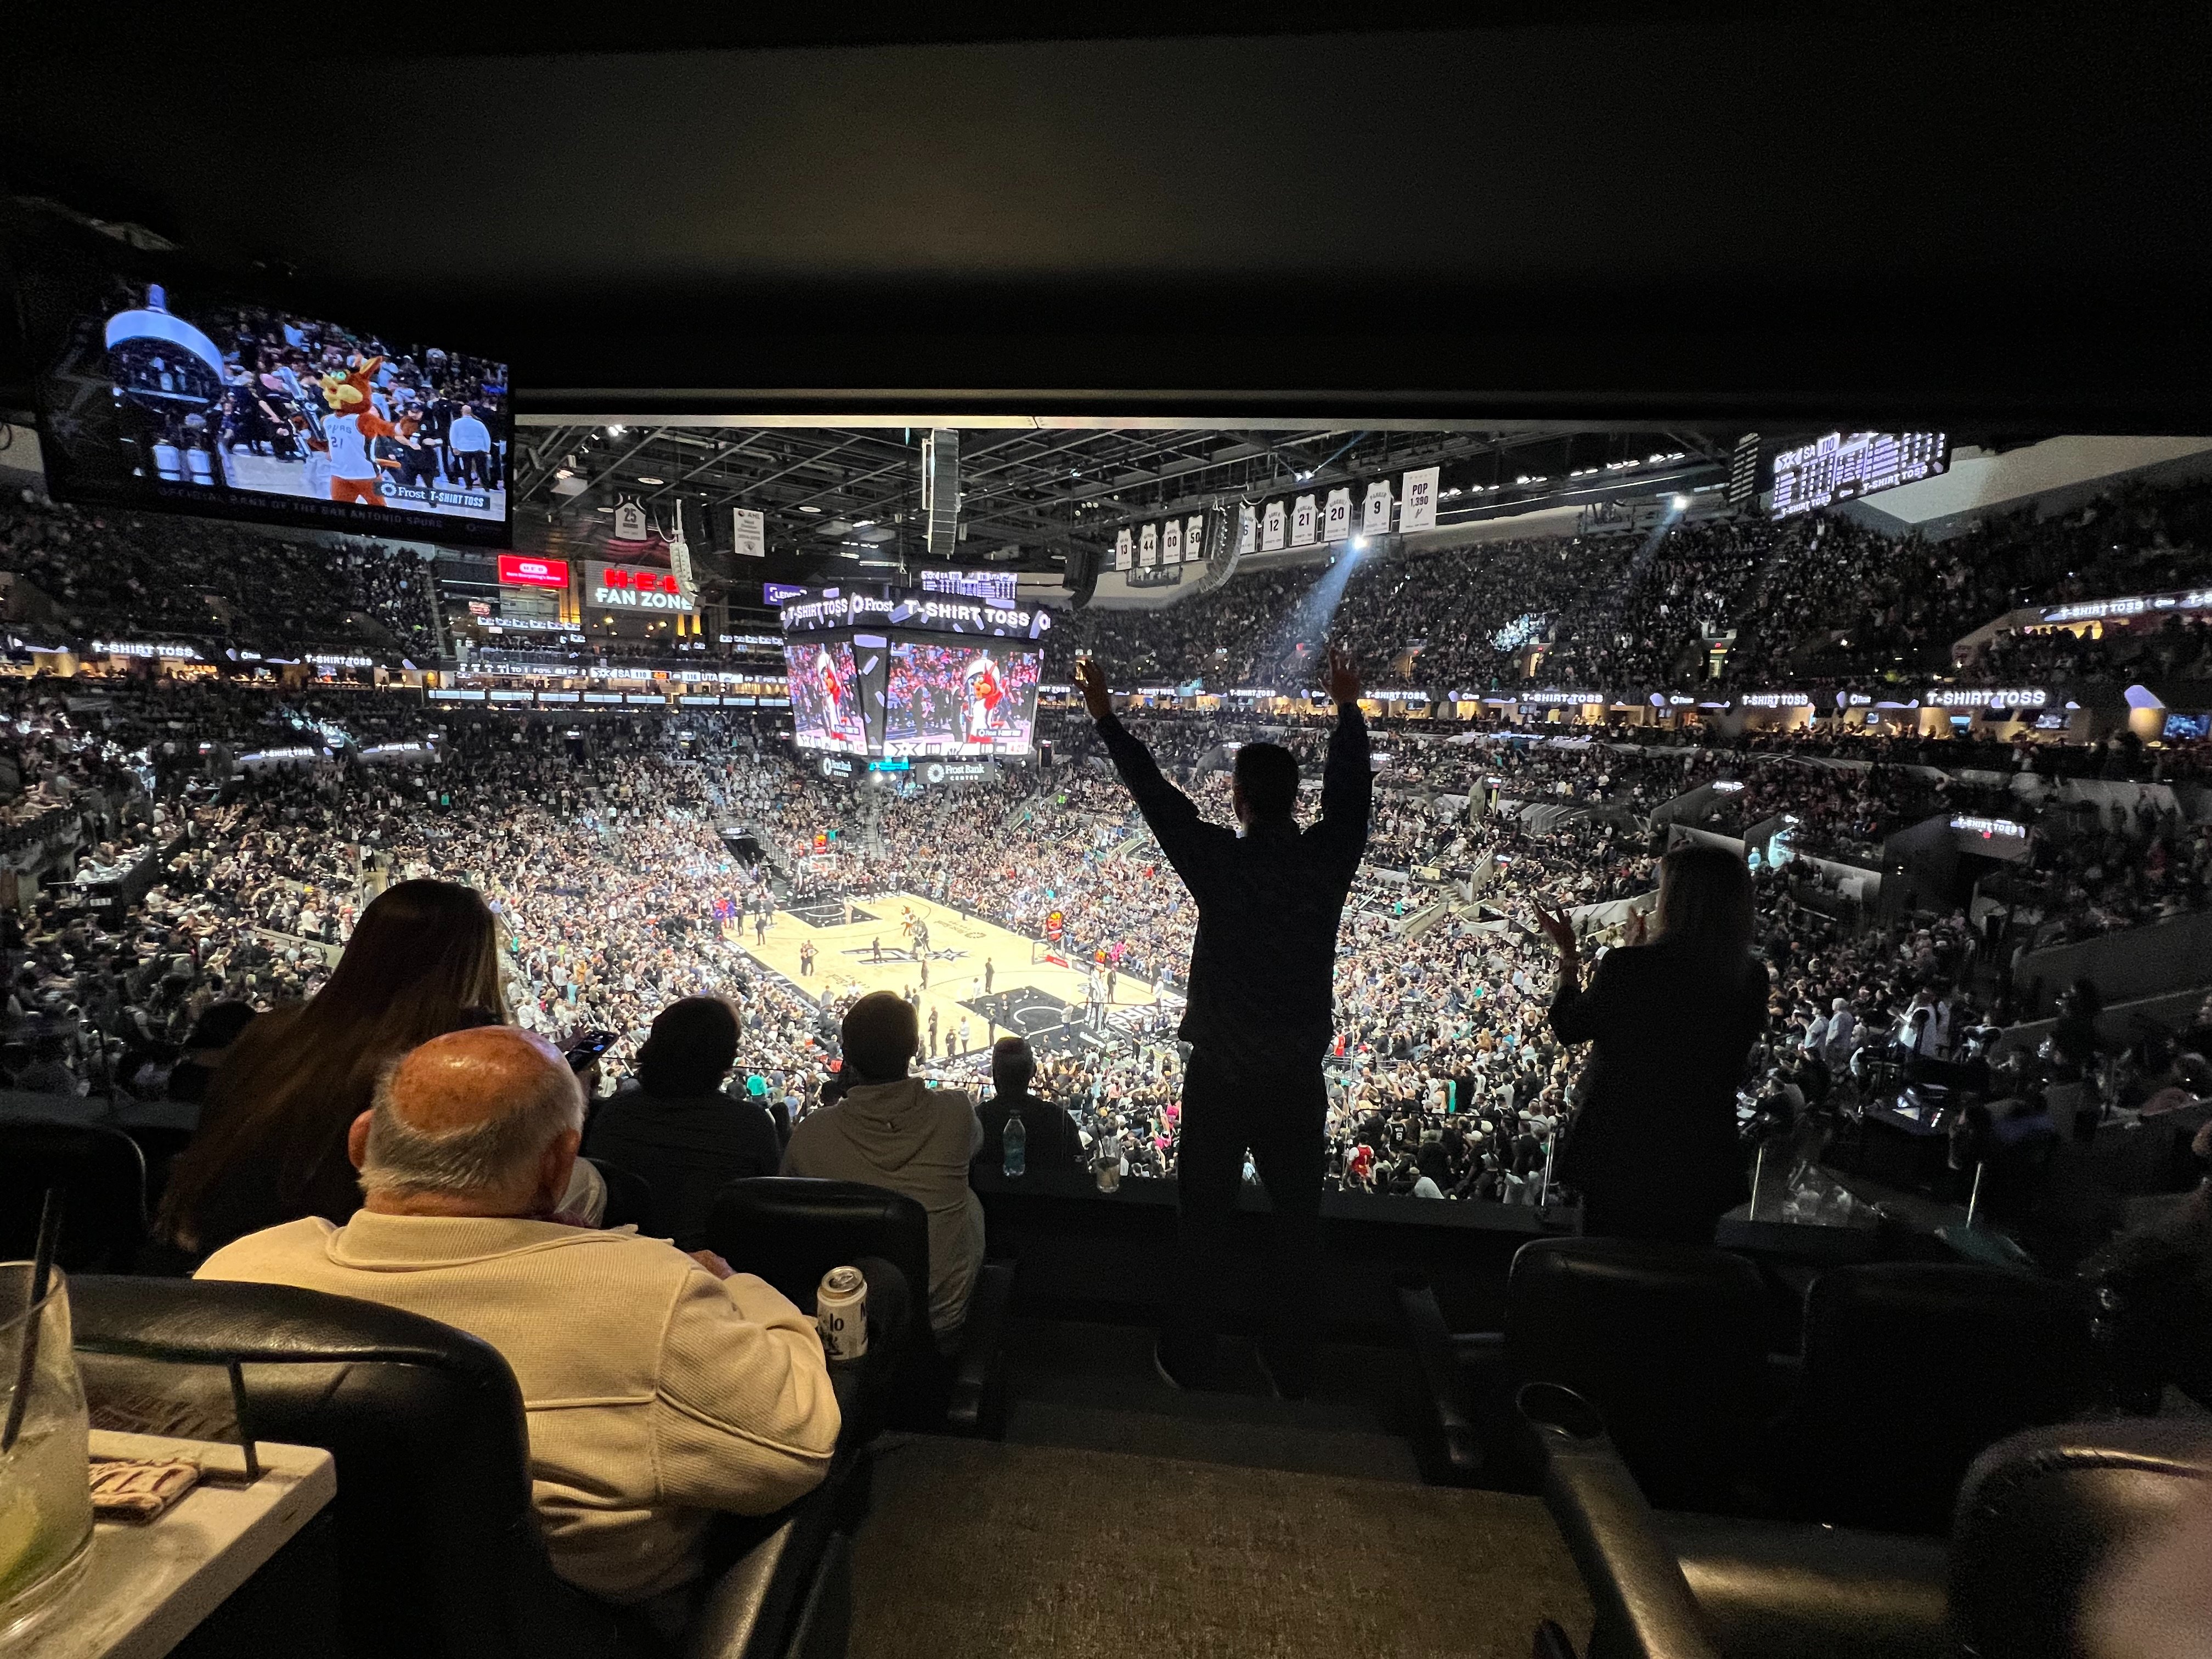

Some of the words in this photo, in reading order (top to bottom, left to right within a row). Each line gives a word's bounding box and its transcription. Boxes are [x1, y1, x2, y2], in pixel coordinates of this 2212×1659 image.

[331, 437, 343, 448] 21
[1804, 445, 1815, 459] SA
[1863, 474, 1900, 490] T-SHIRT
[1902, 465, 1928, 479] TOSS
[1412, 483, 1428, 495] POP
[398, 487, 425, 499] Frost
[430, 491, 462, 504] T-SHIRT
[464, 495, 484, 507] TOSS
[1410, 495, 1429, 507] 1,390
[1374, 501, 1381, 514] 9
[1782, 501, 1810, 516] T-SHIRT
[1812, 495, 1831, 506] TOSS
[350, 510, 401, 523] ANTONIO
[624, 507, 637, 523] 25
[1299, 513, 1310, 526] 21
[1331, 507, 1344, 521] 20
[1270, 520, 1279, 532] 12
[1167, 536, 1177, 548] 00
[1190, 532, 1200, 544] 50
[1121, 544, 1127, 555] 13
[1144, 540, 1154, 551] 44
[595, 588, 636, 605] FAN
[641, 591, 693, 611] ZONE
[788, 602, 822, 619] T-SHIRT
[823, 598, 848, 615] TOSS
[864, 597, 894, 612] Frost
[904, 600, 981, 620] T-SHIRT
[984, 608, 1030, 627] TOSS
[2060, 605, 2109, 617] T-SHIRT
[2110, 601, 2144, 612] TOSS
[92, 643, 154, 654] T-SHIRT
[156, 646, 194, 657] TOSS
[305, 654, 346, 664] T-SHIRT
[346, 657, 373, 665] TOSS
[617, 668, 630, 678] SA
[702, 673, 718, 681] UTA
[1365, 691, 1401, 699] T-SHIRT
[1402, 691, 1427, 699] TOSS
[1522, 693, 1568, 702] T-SHIRT
[1570, 693, 1603, 703] TOSS
[1742, 695, 1780, 705] T-SHIRT
[1781, 695, 1808, 705] TOSS
[1927, 692, 1993, 705] T-SHIRT
[1997, 691, 2046, 704] TOSS
[945, 764, 964, 774] Frost
[965, 763, 985, 774] Bank
[1958, 817, 1993, 830] T-SHIRT
[1993, 823, 2017, 833] TOSS
